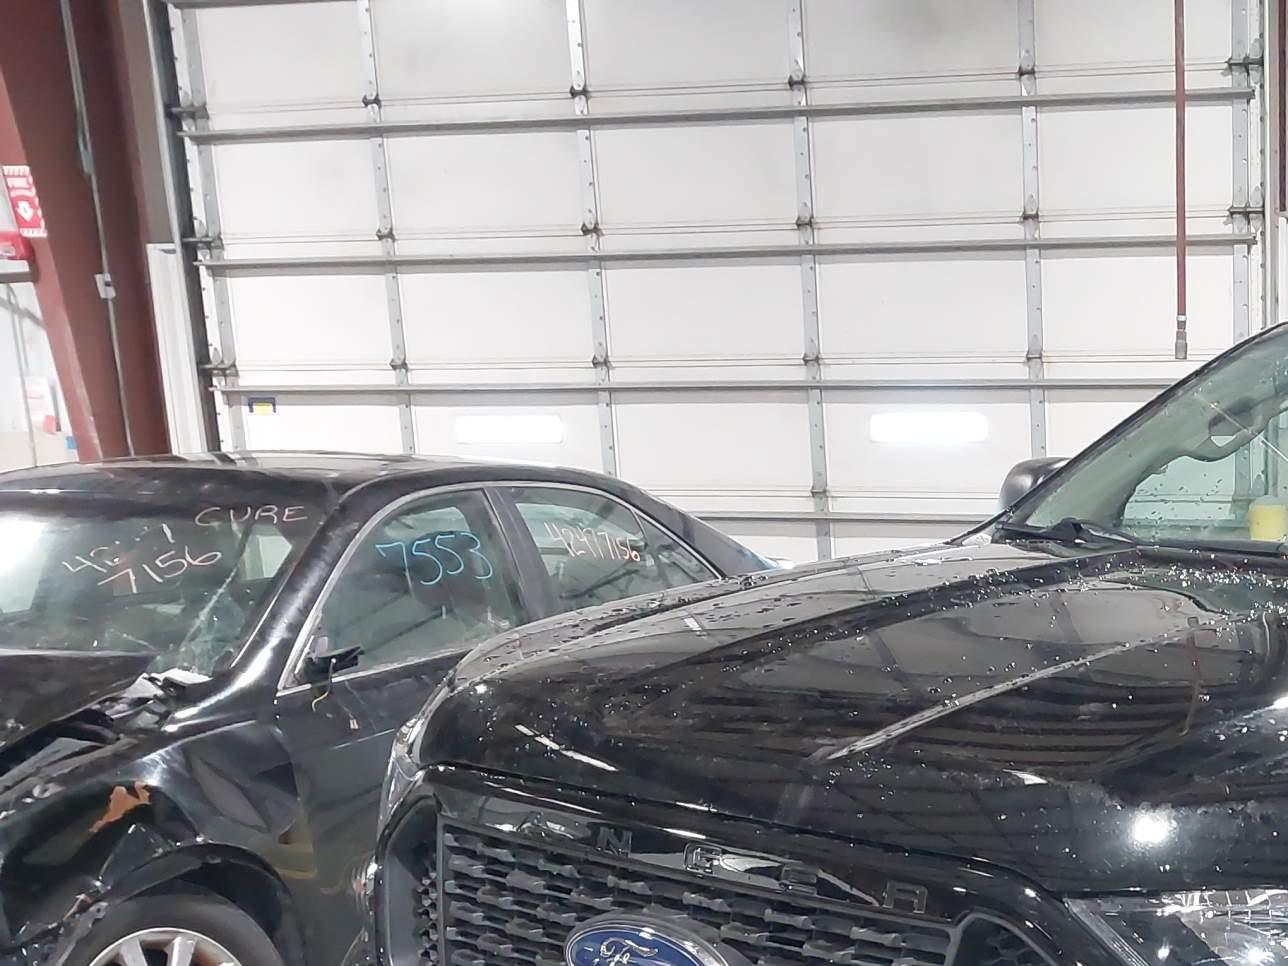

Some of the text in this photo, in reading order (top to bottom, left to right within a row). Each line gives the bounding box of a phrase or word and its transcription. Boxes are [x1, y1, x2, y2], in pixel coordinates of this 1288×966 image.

[193, 504, 309, 527] CURE
[97, 545, 223, 595] 7156
[374, 531, 494, 586] 7553
